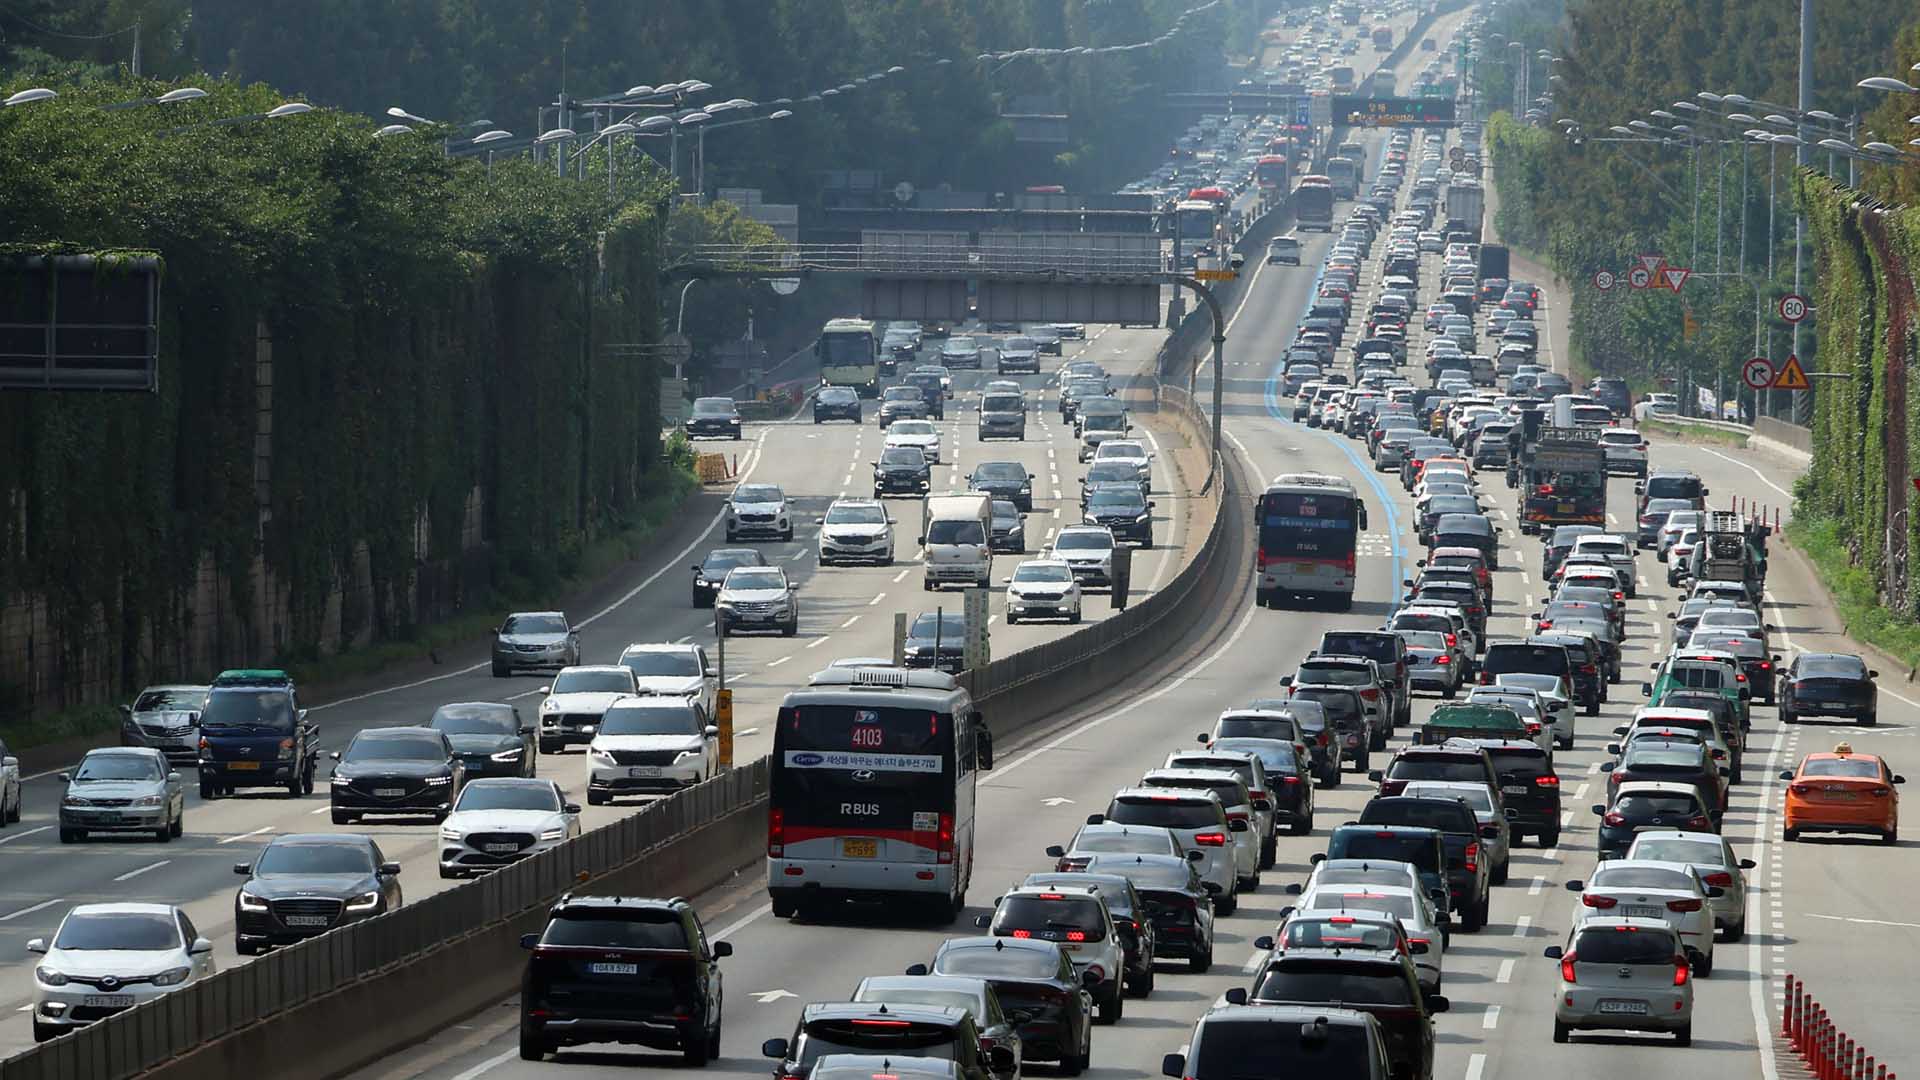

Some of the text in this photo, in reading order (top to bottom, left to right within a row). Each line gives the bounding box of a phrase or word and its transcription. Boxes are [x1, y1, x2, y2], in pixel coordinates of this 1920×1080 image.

[1599, 275, 1610, 285] 80
[1785, 303, 1802, 315] 80
[853, 728, 882, 746] 4103
